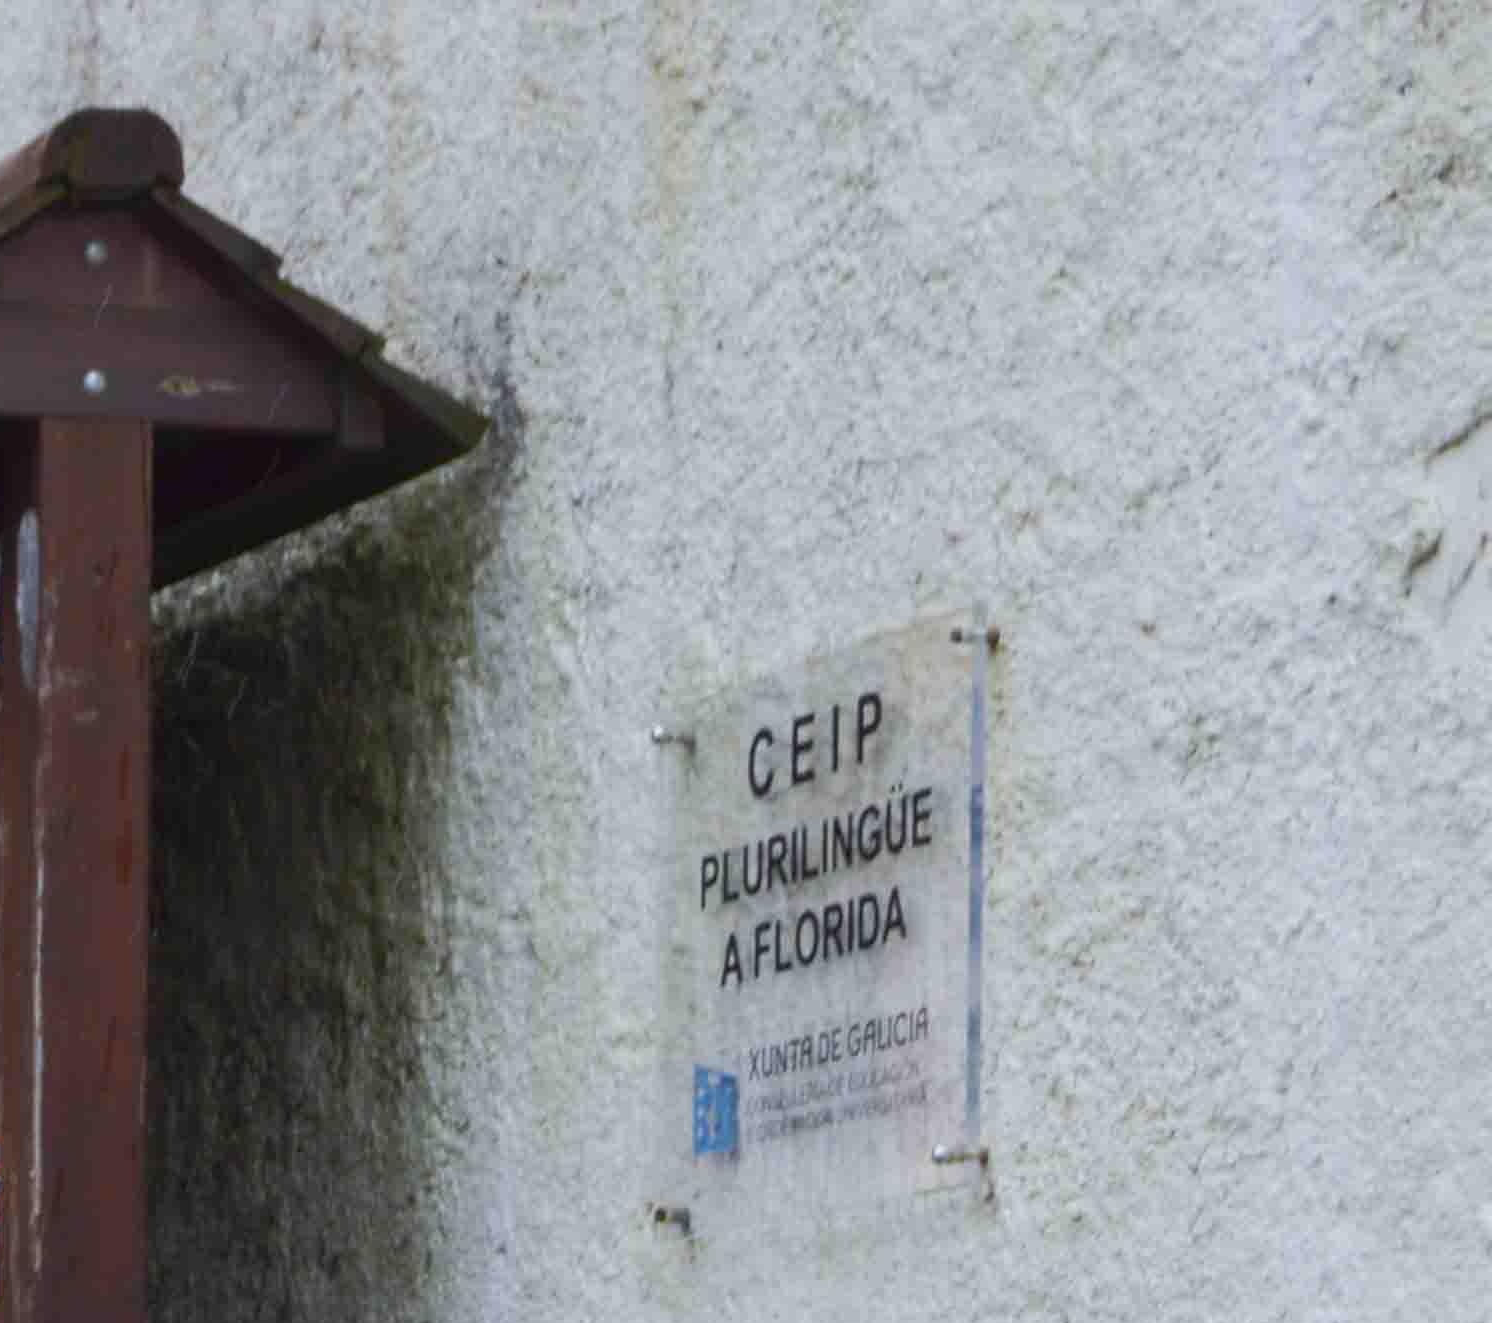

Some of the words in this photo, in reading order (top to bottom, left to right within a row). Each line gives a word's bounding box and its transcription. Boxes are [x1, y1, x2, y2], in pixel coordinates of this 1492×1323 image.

[747, 692, 883, 799] CEIP
[700, 781, 933, 912] PLURILINGÜE
[719, 930, 744, 988] A
[753, 884, 907, 979] FLORIDA
[747, 1035, 815, 1081] XUNTA
[819, 1027, 844, 1065] DE
[846, 1005, 930, 1058] GALICIA
